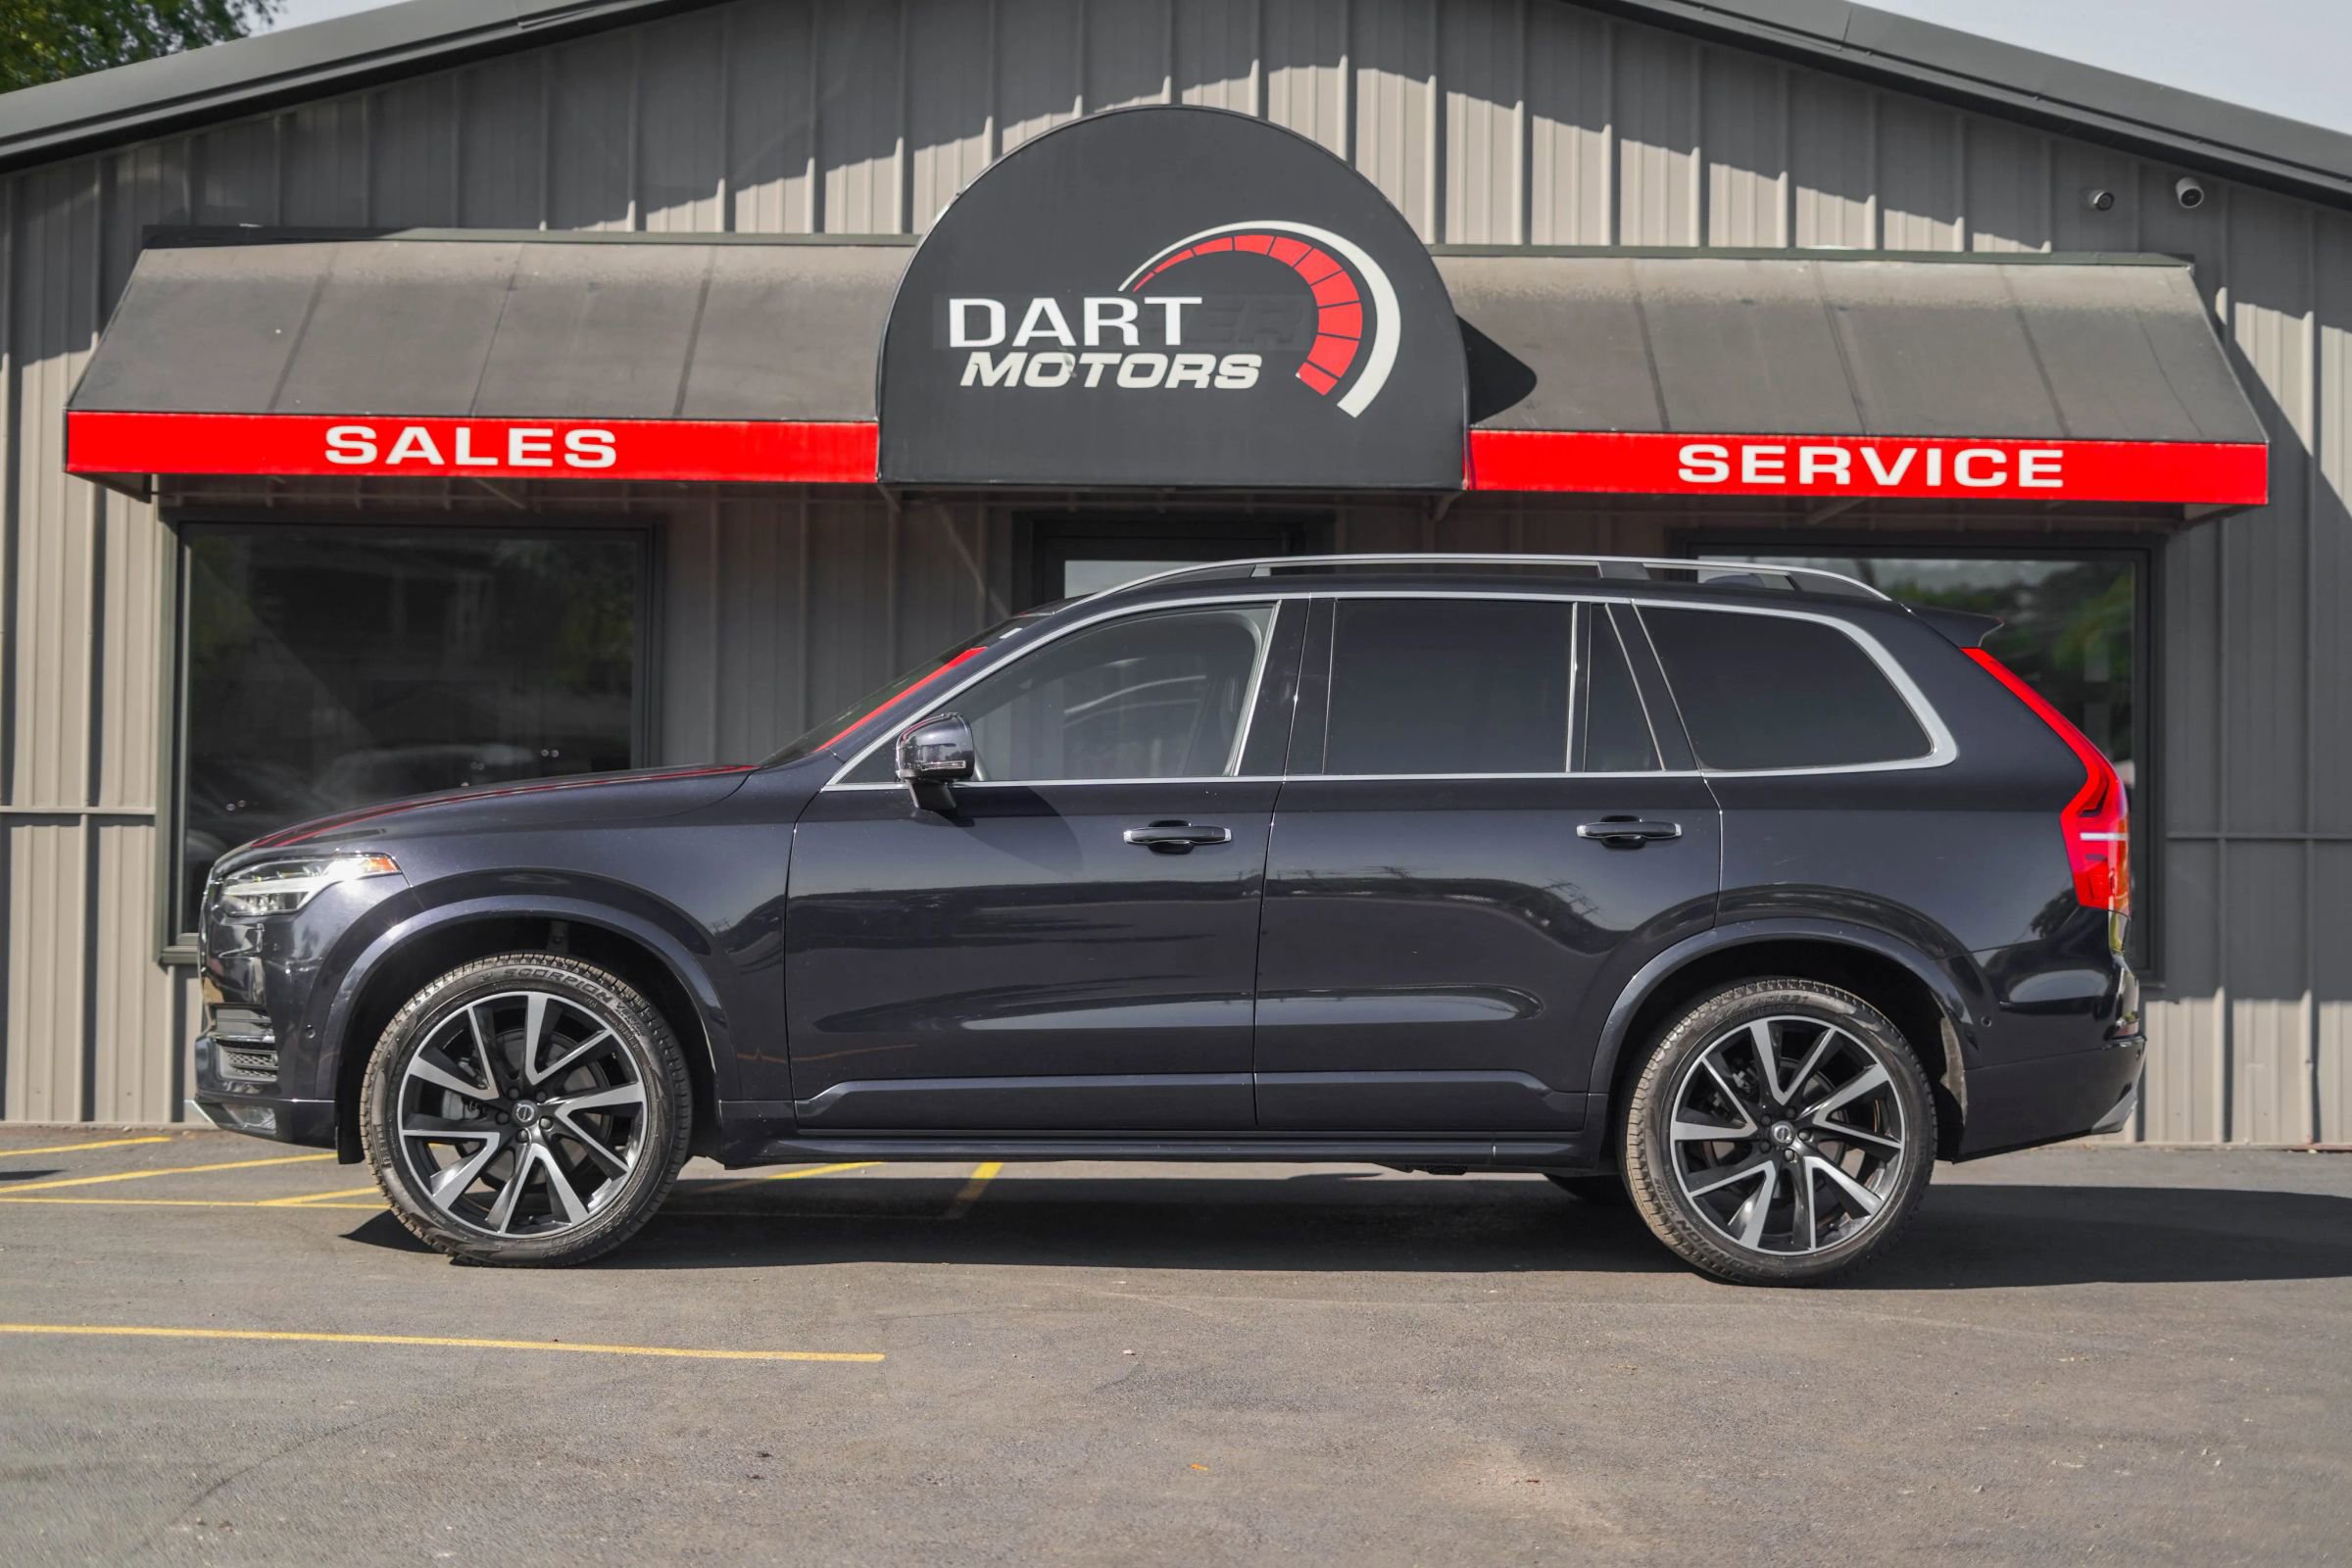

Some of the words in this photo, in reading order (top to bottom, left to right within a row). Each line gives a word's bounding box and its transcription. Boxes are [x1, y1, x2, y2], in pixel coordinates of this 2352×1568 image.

[949, 296, 1202, 347] DART
[959, 352, 1262, 389] MOTORS
[326, 426, 615, 467] SALES
[1679, 445, 2062, 487] SERVICE
[504, 967, 612, 1004] SCORPION
